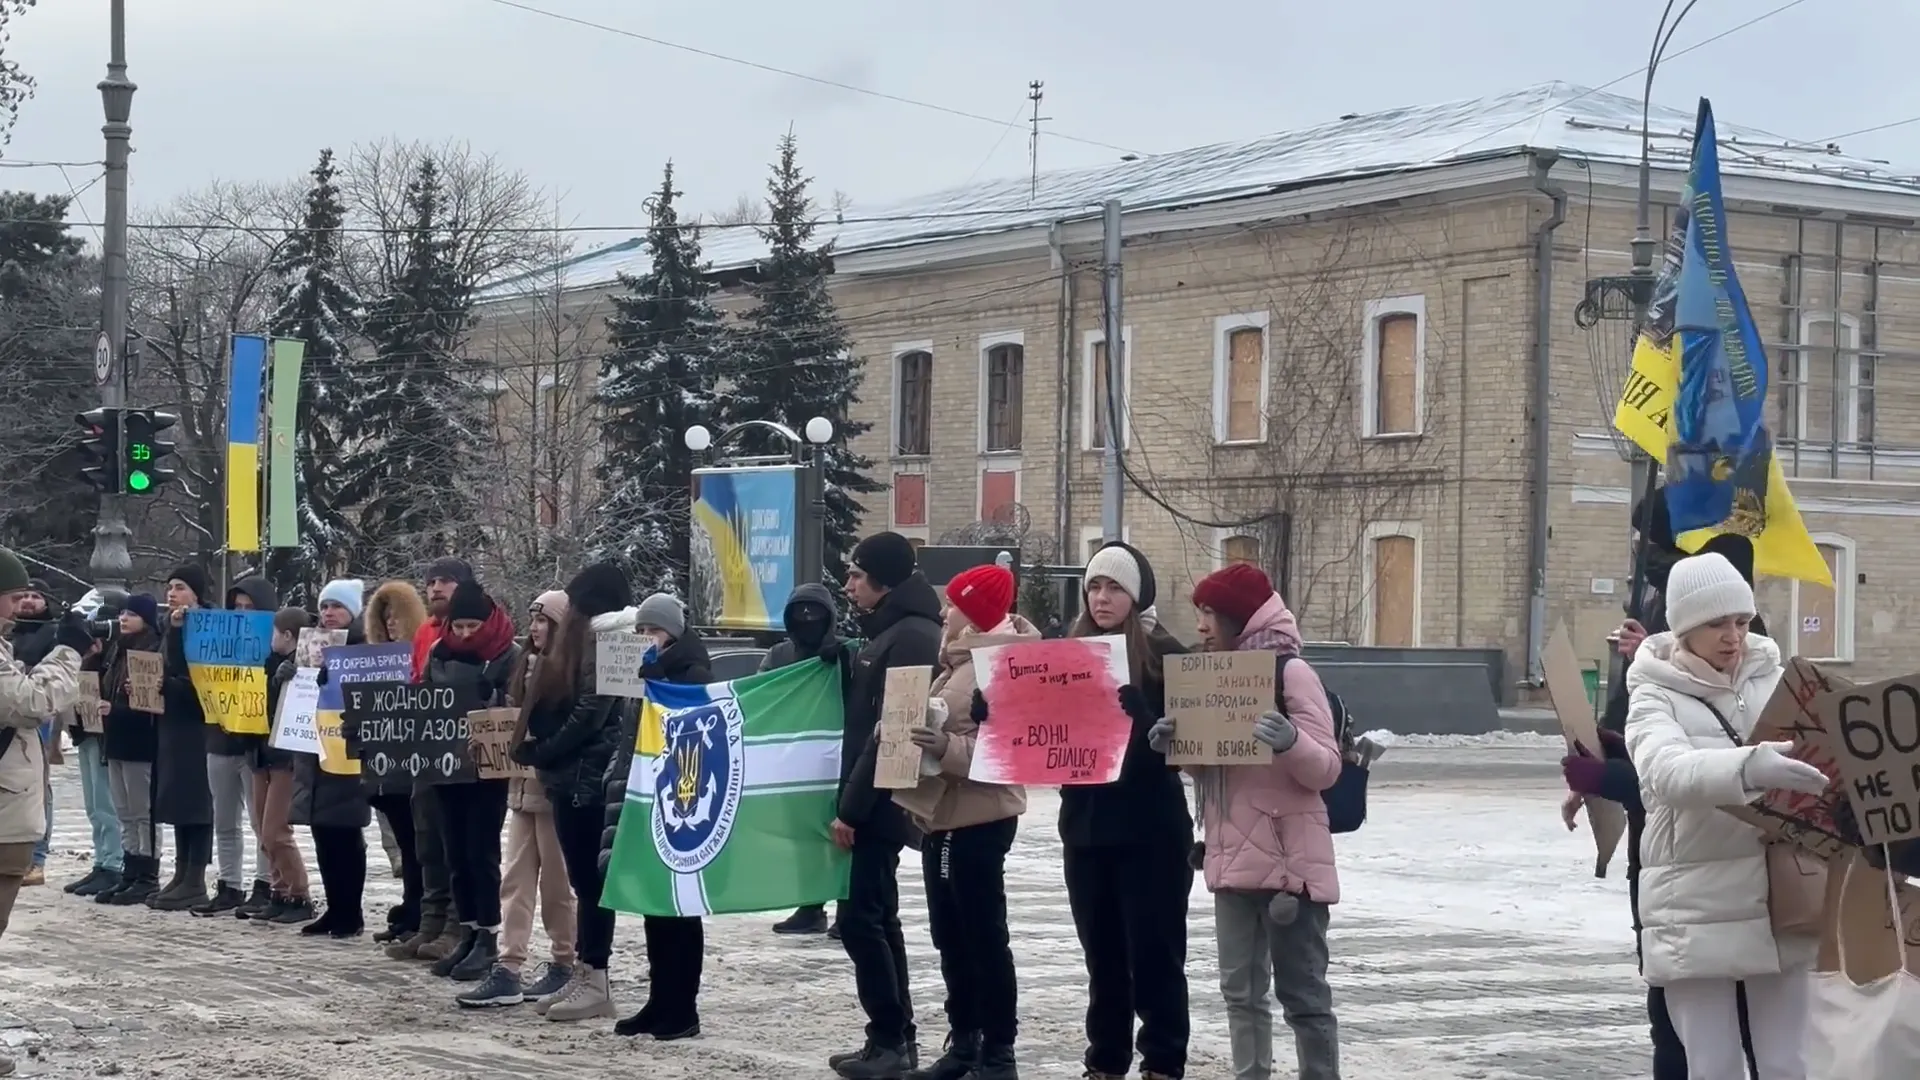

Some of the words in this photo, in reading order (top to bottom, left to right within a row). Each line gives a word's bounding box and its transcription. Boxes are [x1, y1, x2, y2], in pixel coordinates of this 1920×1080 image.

[193, 613, 252, 635] ВЕРНІТЬ
[199, 636, 261, 662] НАШОГО
[328, 658, 341, 670] 23
[1008, 656, 1049, 680] Битися
[1181, 655, 1233, 672] БОРІТЬСЯ
[371, 685, 455, 712] ЖОДНОГО
[357, 717, 416, 743] БІЙЦЯ
[1027, 723, 1069, 747] ВОНИ
[1046, 746, 1098, 770] БИЛИСЯ
[1168, 740, 1203, 757] ПОЛОН
[1854, 770, 1893, 801] НЕ
[1864, 802, 1920, 838] ПО
